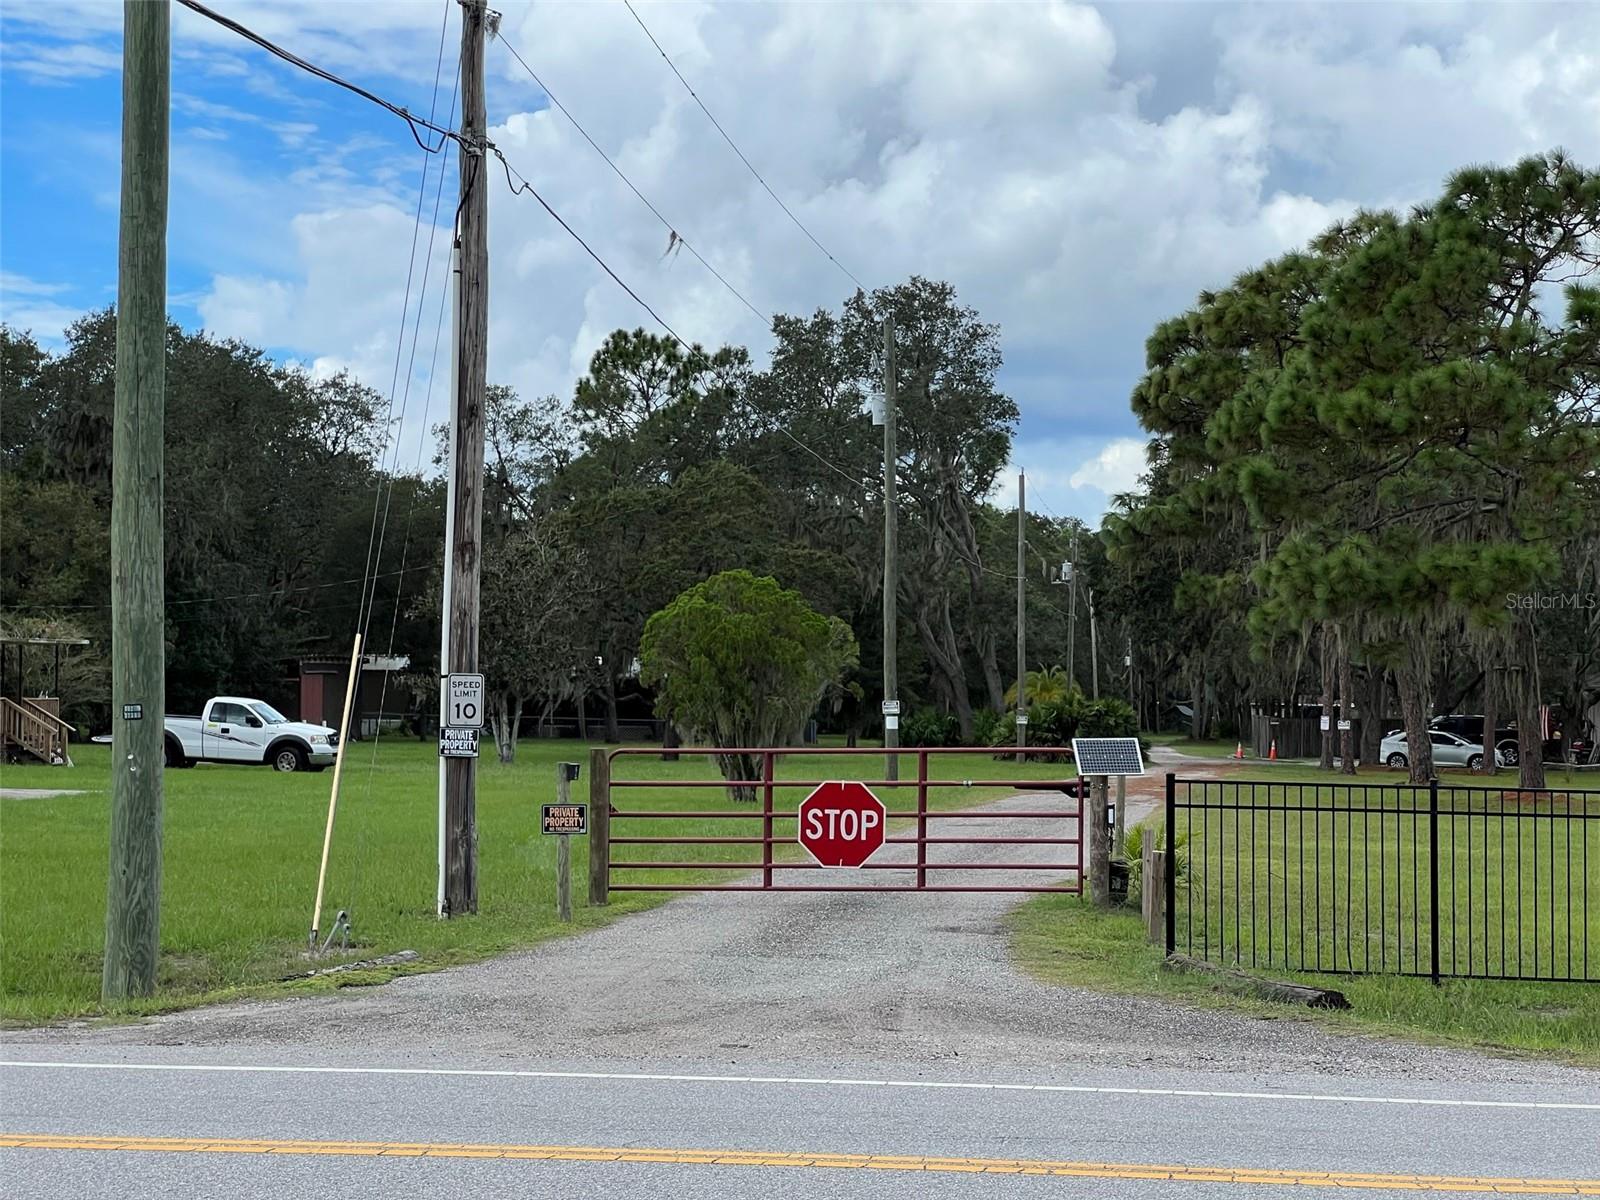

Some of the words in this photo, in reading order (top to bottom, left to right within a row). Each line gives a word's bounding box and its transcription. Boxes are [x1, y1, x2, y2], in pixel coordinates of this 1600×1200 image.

[452, 681, 480, 689] SPEED
[455, 703, 476, 719] 10
[445, 729, 474, 740] PRIVATE
[440, 740, 477, 750] PROPERTY
[550, 807, 579, 817] PRIVATE
[545, 817, 583, 827] PROPERTY
[806, 808, 879, 840] STOP
